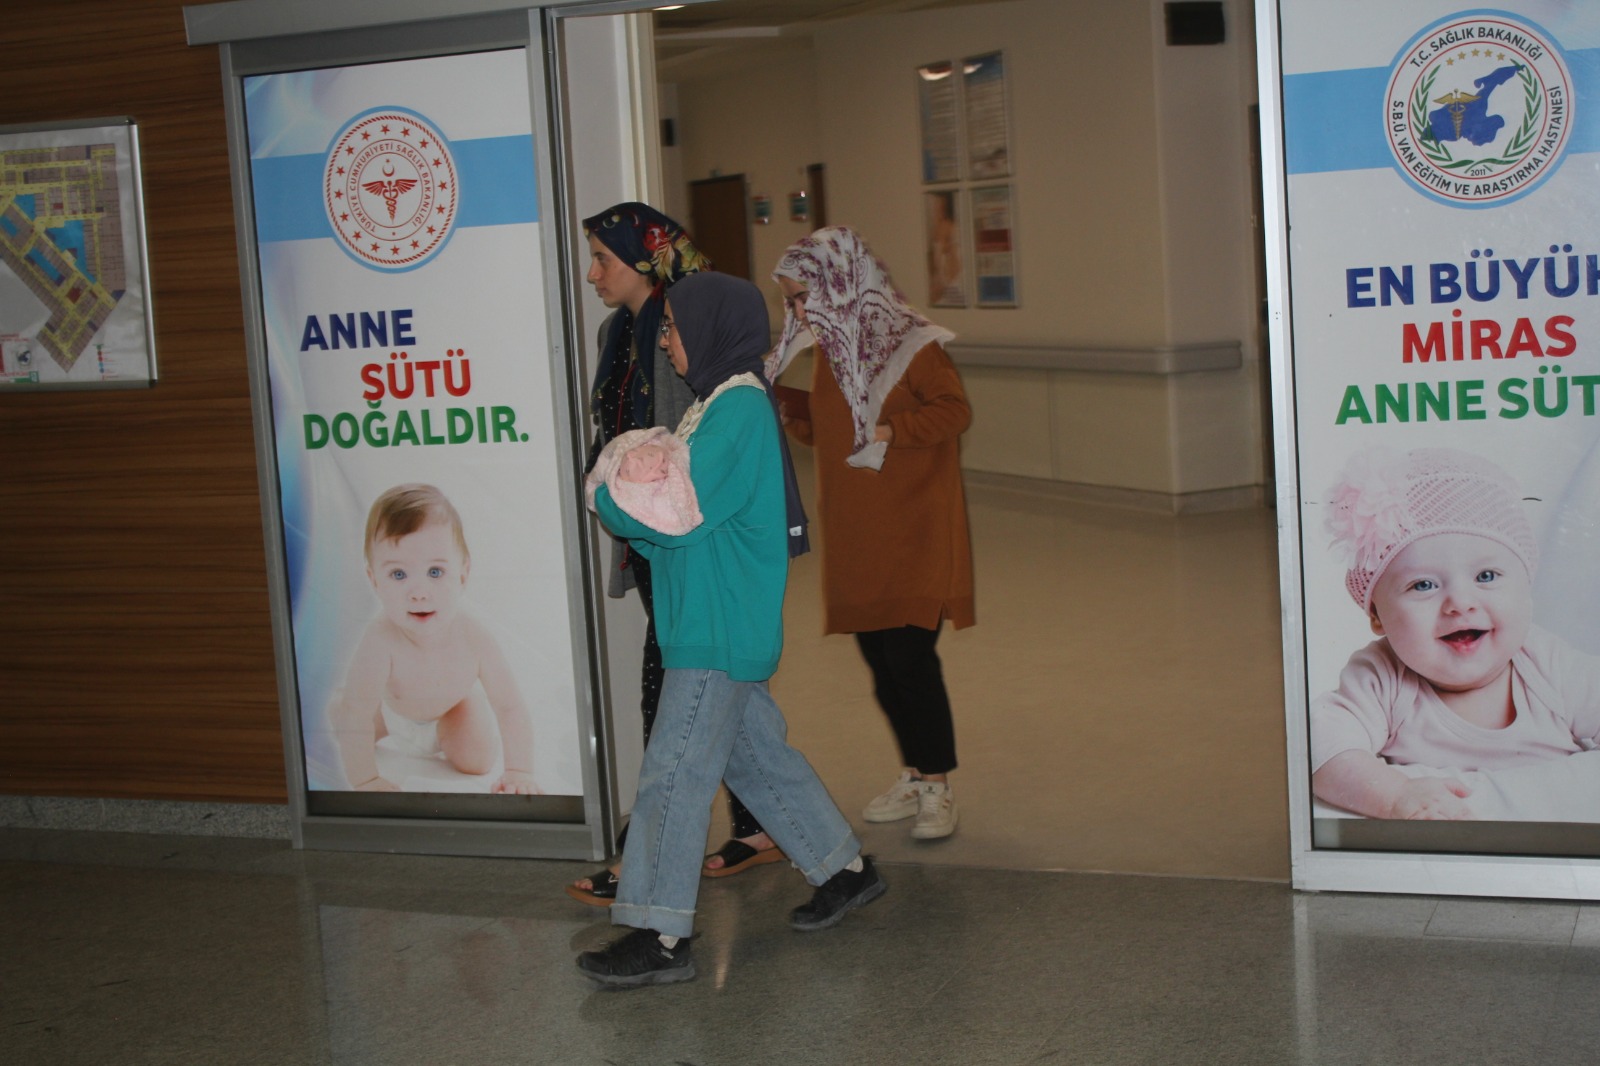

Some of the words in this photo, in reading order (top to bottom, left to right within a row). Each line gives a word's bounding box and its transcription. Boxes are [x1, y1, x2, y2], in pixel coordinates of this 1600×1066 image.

[1410, 51, 1432, 68] T.C.
[1430, 28, 1475, 52] SAĞLIK
[1477, 27, 1543, 61] BAKANLIĞI
[1392, 100, 1404, 137] S.B.Ü.
[1538, 85, 1563, 157] HASTANESİ
[350, 142, 393, 191] CUMHURİYETİ
[396, 144, 425, 170] SAĞLIK
[1397, 138, 1414, 164] VAN
[1412, 162, 1451, 191] EĞİTİM
[1454, 183, 1470, 195] VE
[1470, 168, 1486, 177] 2011
[1473, 158, 1543, 196] ARAŞTIRMA
[350, 195, 376, 232] TÜRKİYE
[412, 172, 432, 227] BAKANLIĞI
[1346, 265, 1414, 308] EN
[299, 309, 416, 352] ANNE
[1402, 308, 1577, 363] MİRAS
[360, 348, 471, 401] SÜTÜ
[1334, 379, 1487, 425] ANNE
[303, 399, 530, 450] DOĞALDIR.
